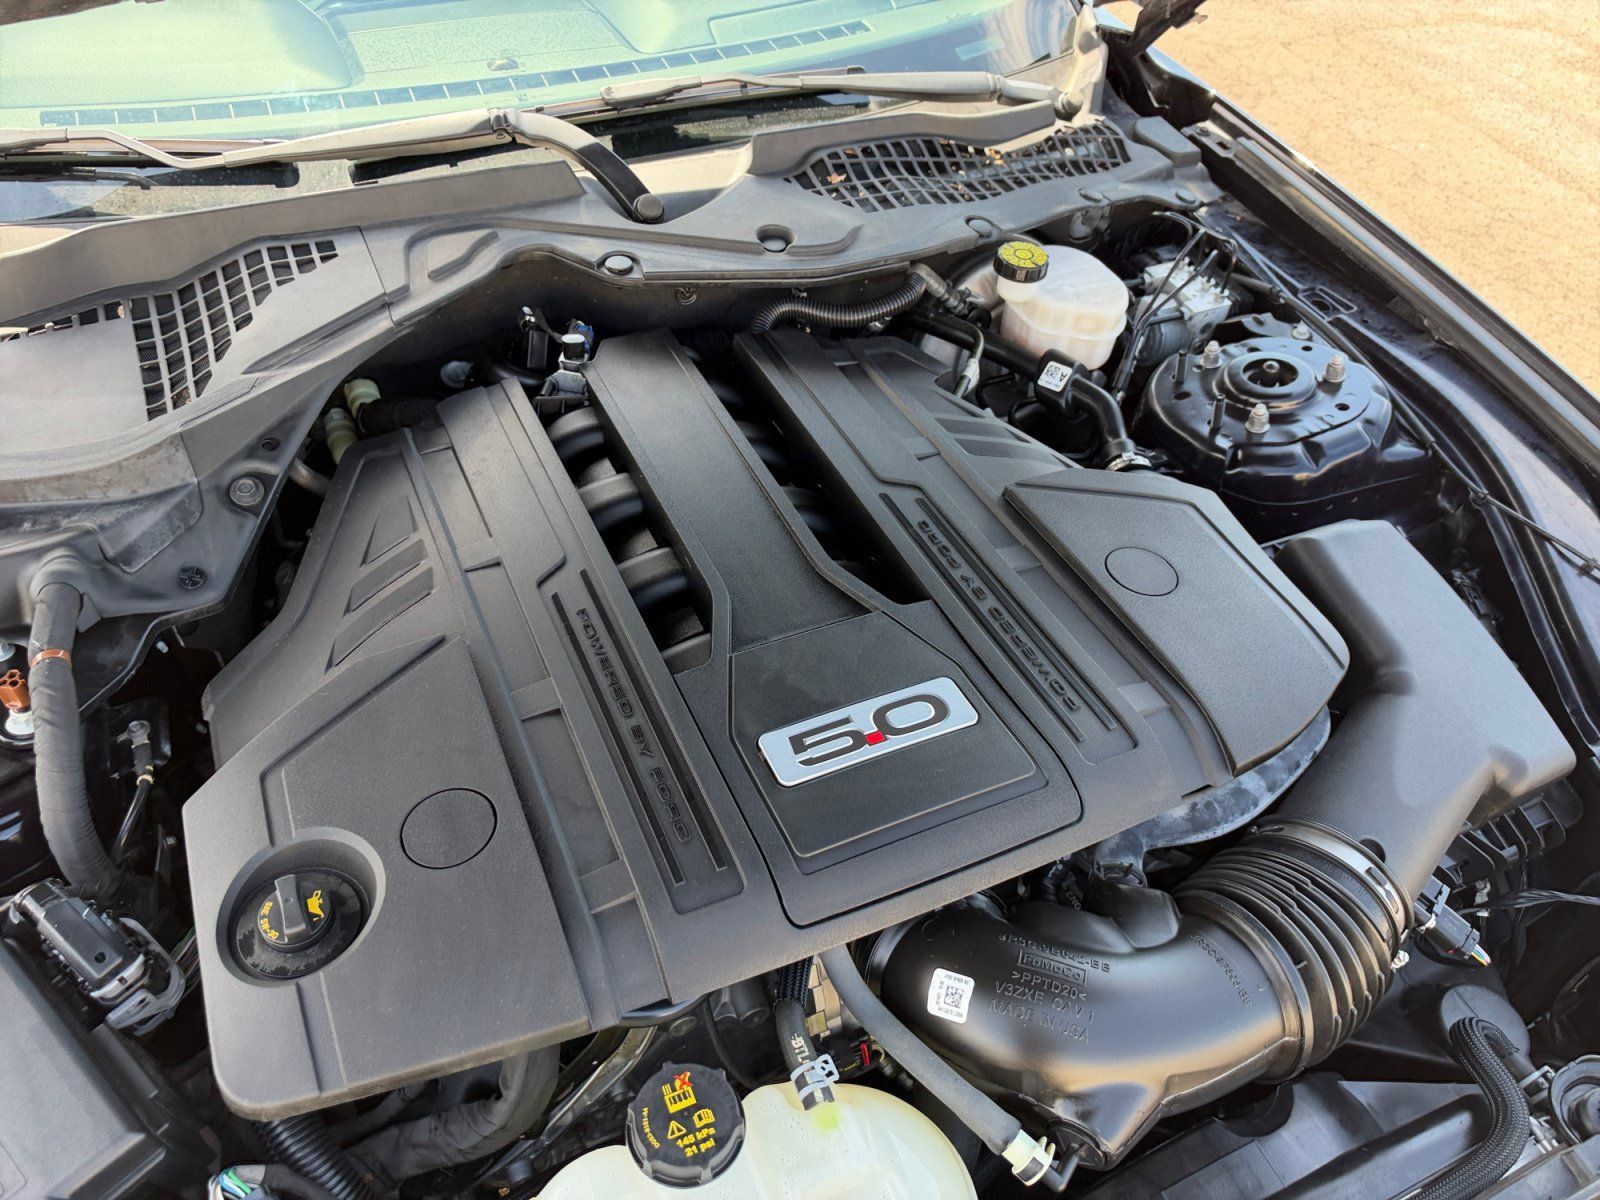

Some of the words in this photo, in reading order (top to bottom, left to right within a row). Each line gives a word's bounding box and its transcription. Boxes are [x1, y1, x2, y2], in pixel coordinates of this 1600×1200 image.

[917, 519, 961, 570] FORD
[961, 574, 988, 600] BY
[988, 605, 1082, 712] POWERED
[576, 607, 634, 718] POWERED
[630, 724, 654, 758] BY
[650, 766, 690, 843] FORD
[788, 693, 950, 767] 5.0
[1022, 953, 1081, 982] FoMoCo
[676, 1133, 696, 1148] 145
[696, 1127, 716, 1141] kPa
[684, 1145, 698, 1157] 21
[700, 1138, 716, 1152] psi
